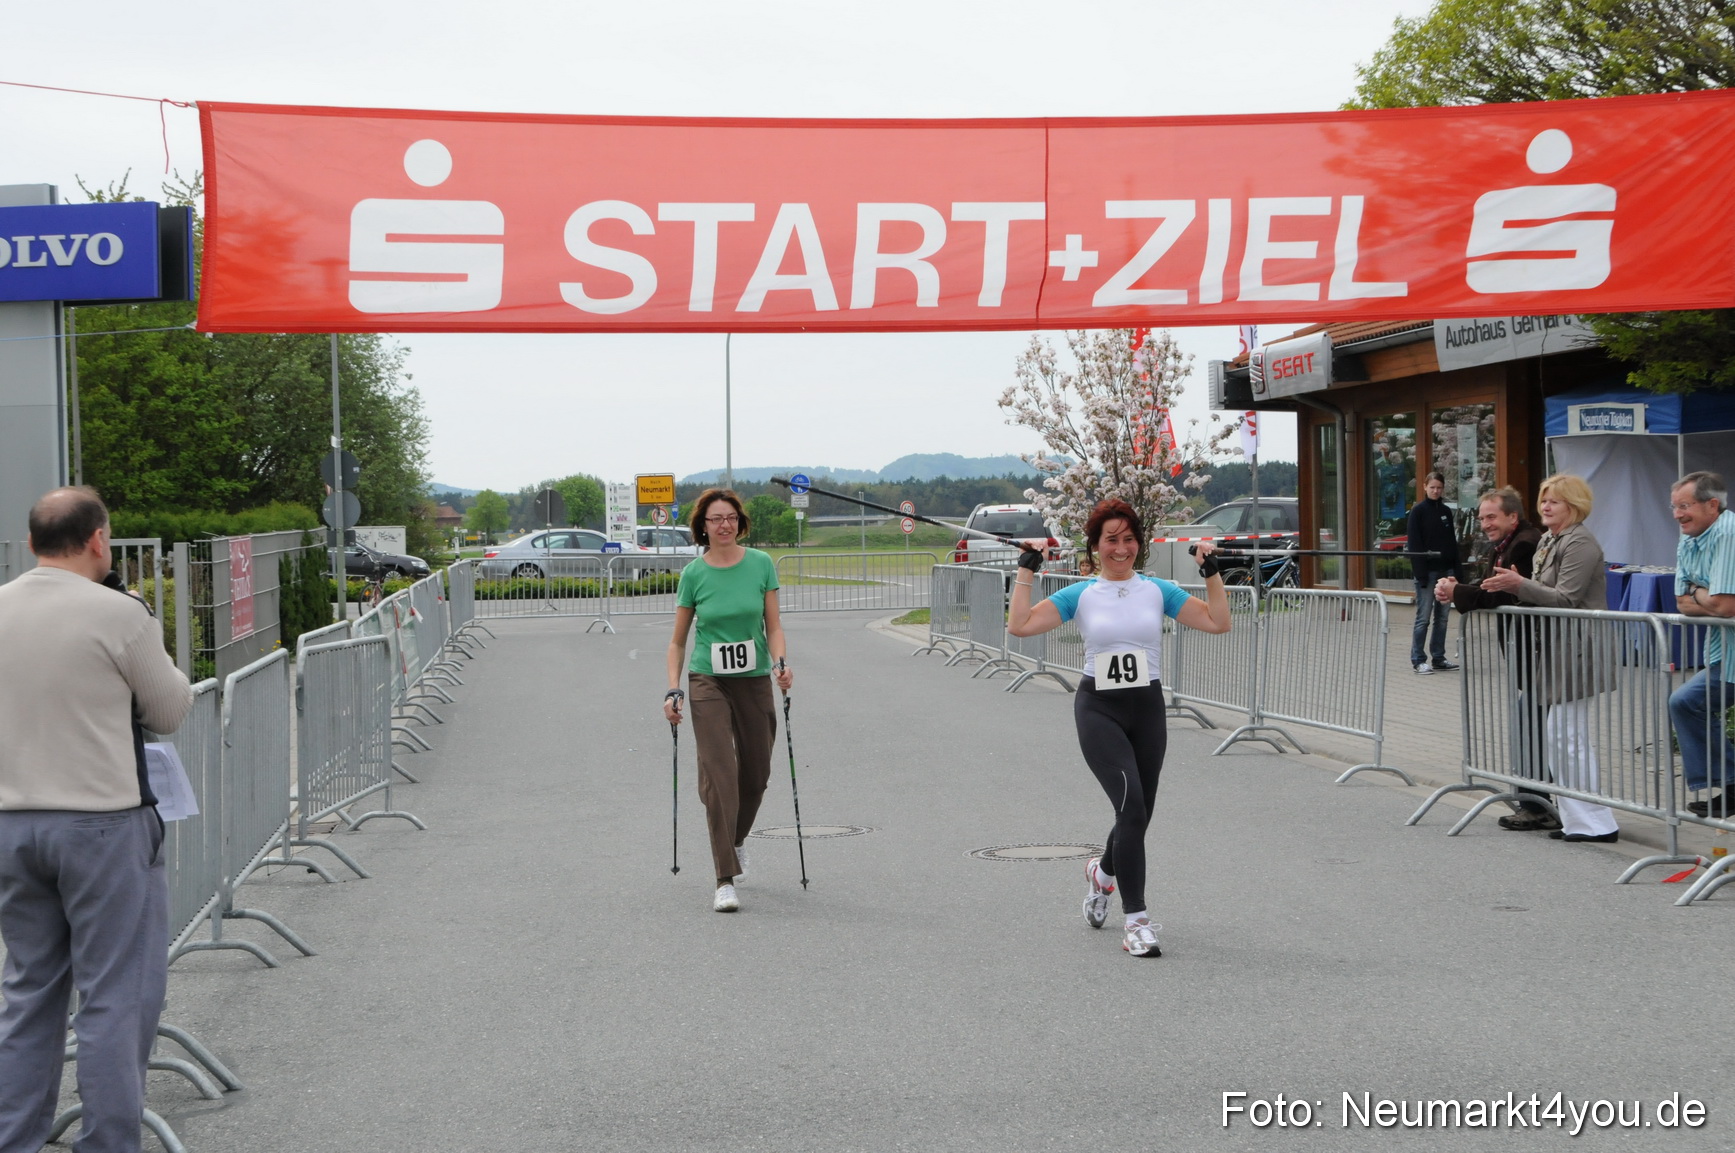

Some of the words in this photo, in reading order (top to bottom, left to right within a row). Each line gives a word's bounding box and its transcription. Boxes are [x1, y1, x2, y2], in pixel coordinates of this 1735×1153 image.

[1445, 319, 1506, 349] Autohaus
[1271, 352, 1315, 380] SEAT
[903, 505, 911, 513] 60
[719, 643, 748, 669] 119
[1107, 653, 1138, 683] 49
